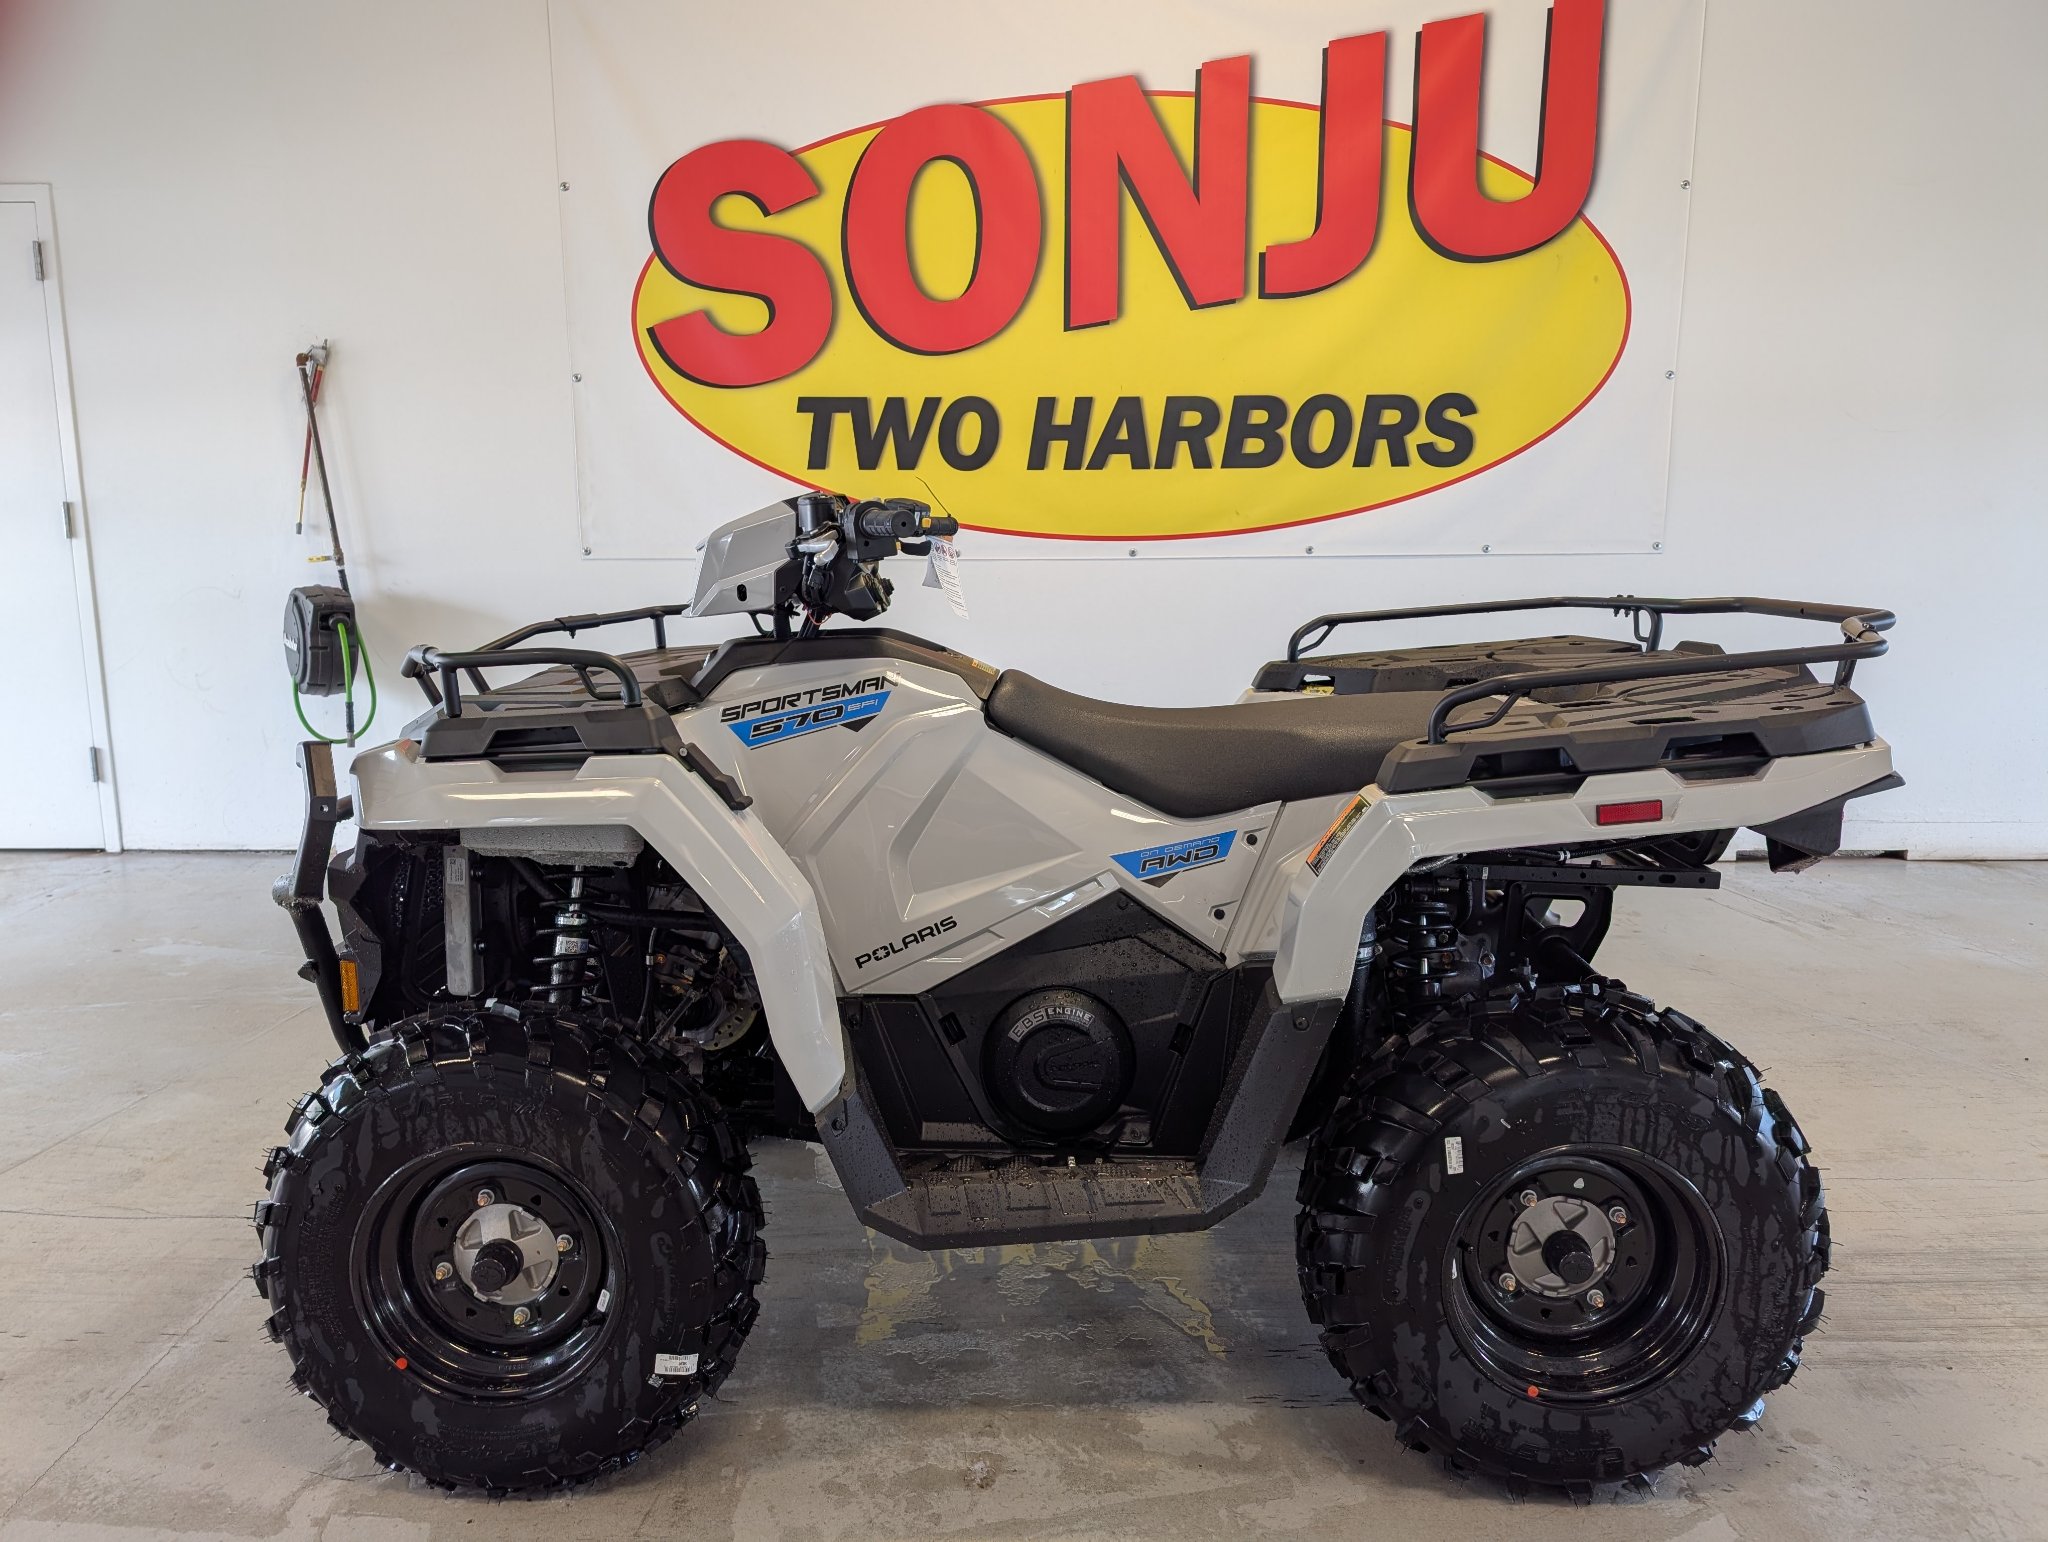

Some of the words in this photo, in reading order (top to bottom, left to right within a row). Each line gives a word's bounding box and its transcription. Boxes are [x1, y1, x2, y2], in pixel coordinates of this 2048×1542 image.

[645, 0, 1604, 389] SONJU
[796, 396, 1000, 471] TWO
[1027, 393, 1479, 471] HARBORS
[720, 674, 899, 723] SPORTSMAN
[750, 704, 844, 739] 570
[1140, 844, 1219, 873] AWD
[854, 915, 958, 969] POLARIS
[1011, 1010, 1045, 1038] EBS
[1046, 1007, 1092, 1021] ENGINE
